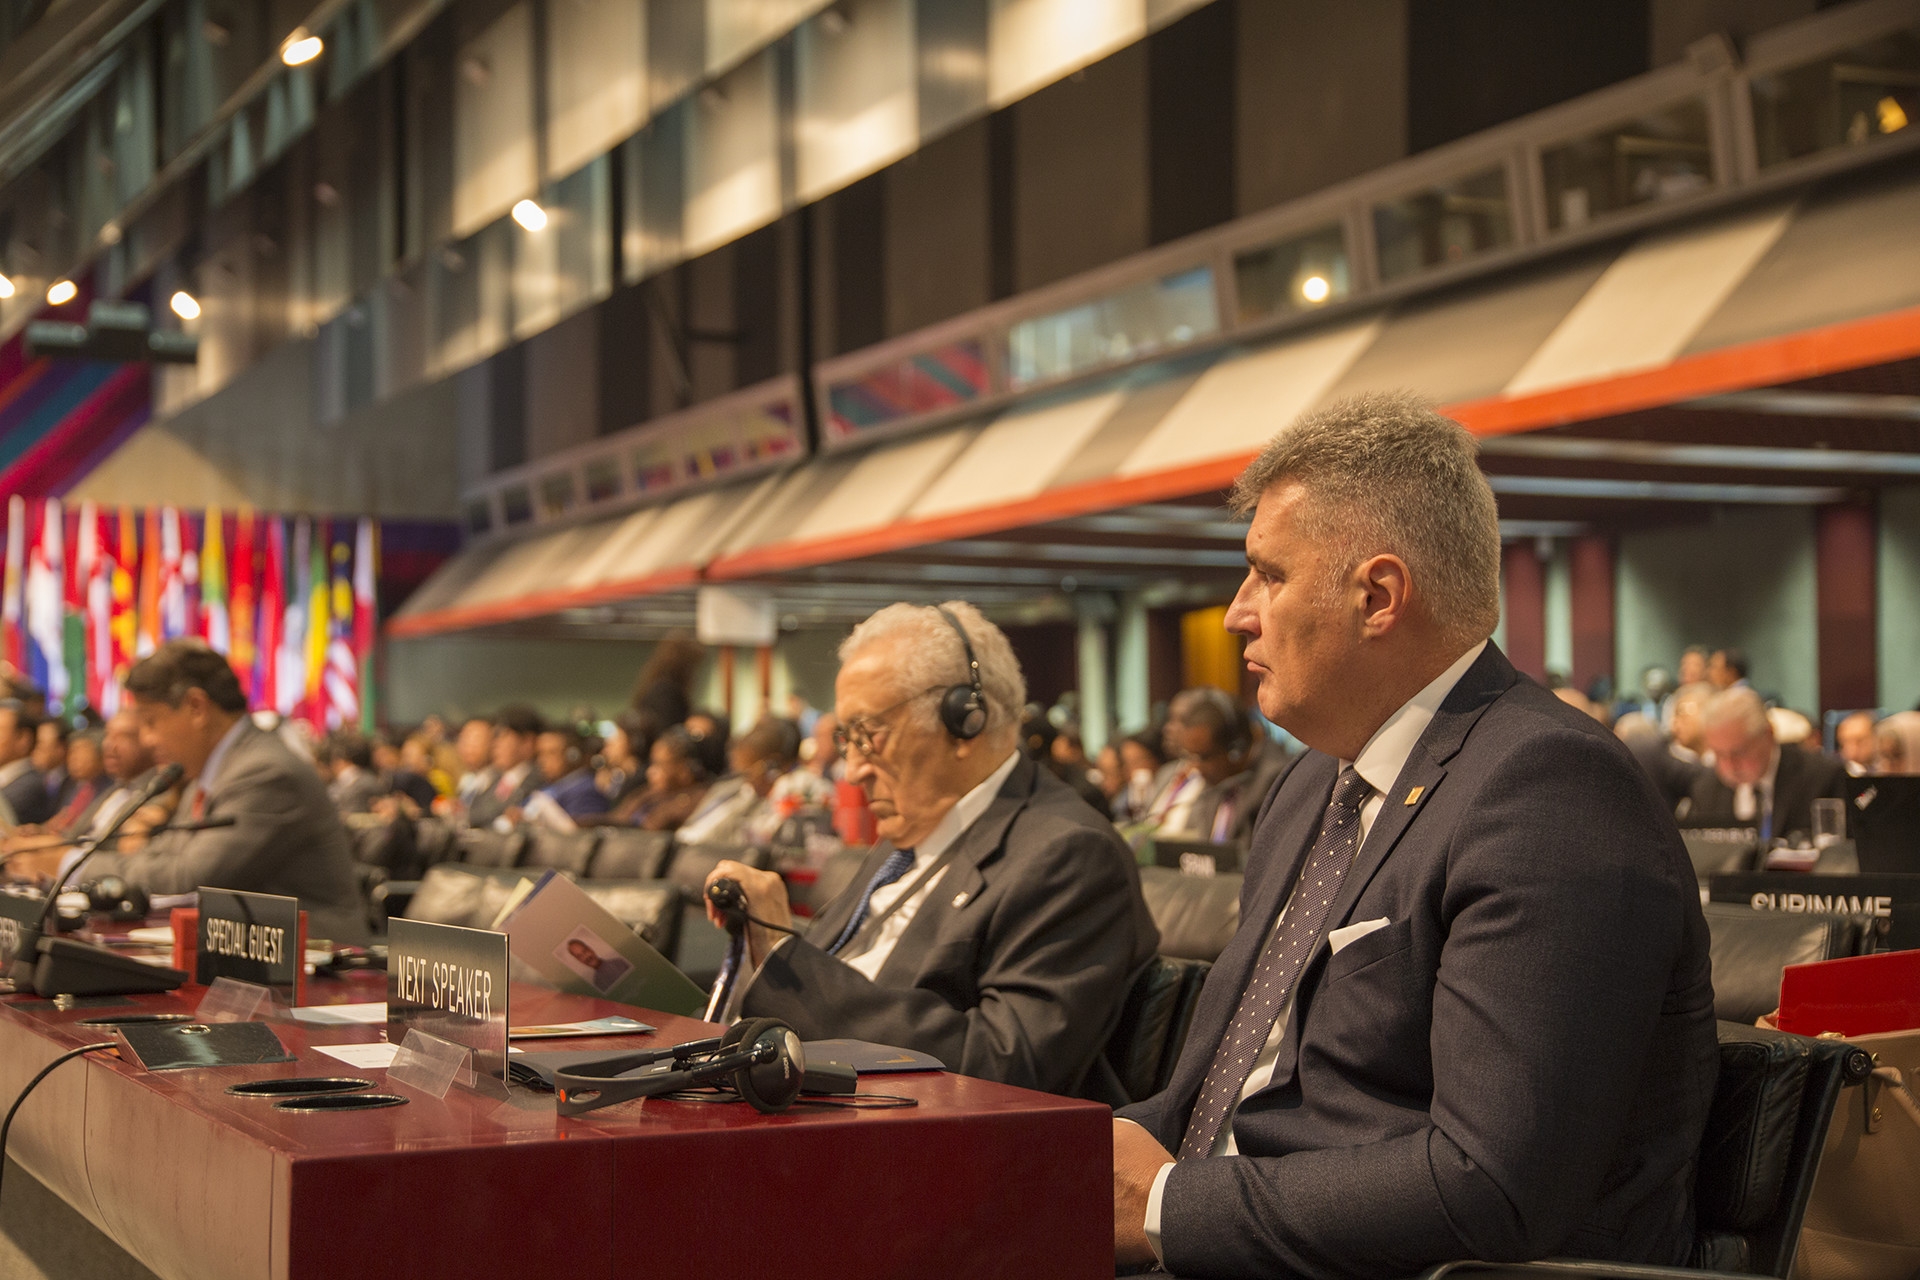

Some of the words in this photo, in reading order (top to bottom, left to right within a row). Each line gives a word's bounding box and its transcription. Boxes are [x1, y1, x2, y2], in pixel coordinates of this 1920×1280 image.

[206, 917, 248, 959] SPECIAL
[249, 924, 284, 965] GUEST
[397, 954, 427, 1004] NEXT
[432, 961, 492, 1022] SPEAKER
